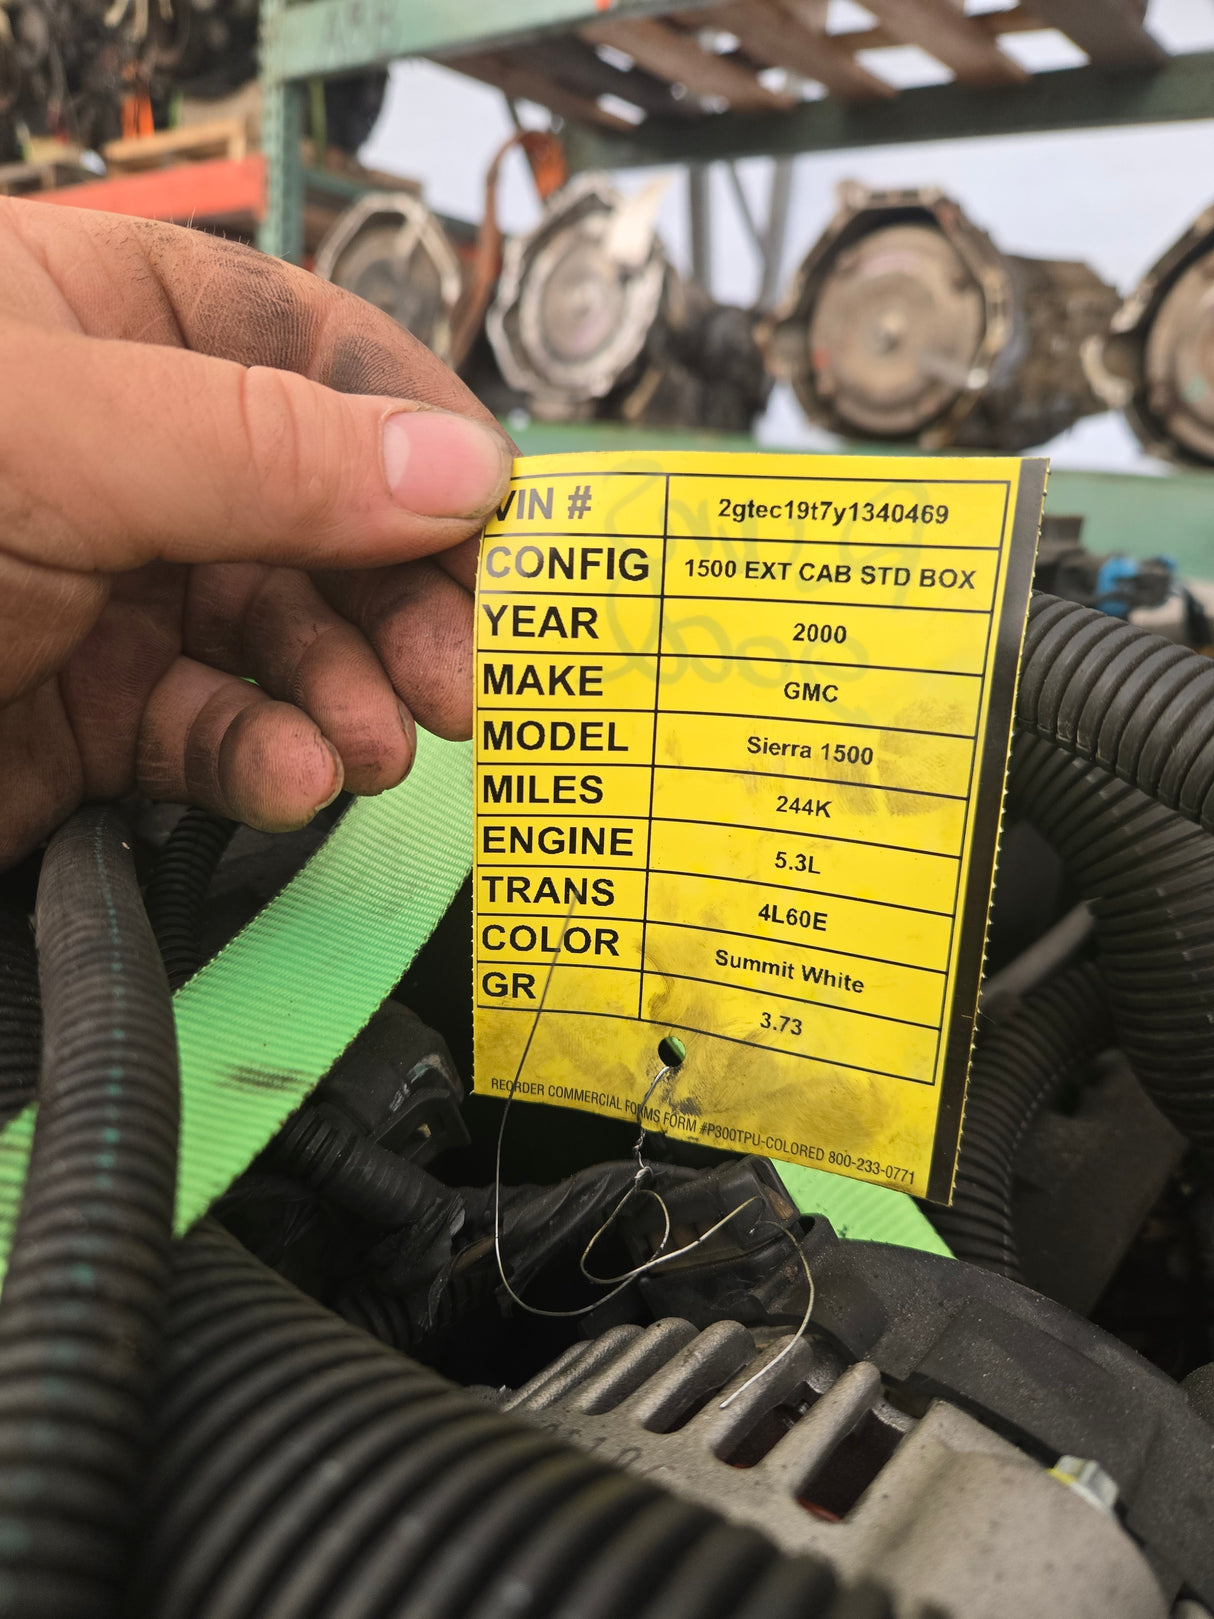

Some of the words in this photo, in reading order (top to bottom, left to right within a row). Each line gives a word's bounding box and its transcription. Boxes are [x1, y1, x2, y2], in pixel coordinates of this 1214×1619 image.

[568, 486, 591, 519] #
[719, 499, 948, 526] 2gtec19t7y1340469
[484, 544, 650, 583] CONFIG
[686, 559, 736, 577] 1500
[745, 561, 792, 580] EXT
[799, 563, 851, 583] CAB
[861, 566, 910, 586] STD
[920, 569, 976, 589] BOX
[483, 605, 598, 639] YEAR
[793, 623, 846, 643] 2000
[484, 664, 603, 696] MAKE
[784, 682, 838, 703] GMC
[484, 721, 628, 751] MODEL
[748, 736, 811, 758] Sierra
[821, 744, 873, 765] 1500
[484, 775, 603, 804] MILES
[776, 796, 831, 818] 244K
[484, 826, 633, 856] ENGINE
[775, 852, 820, 874] 5.3L
[482, 876, 614, 906] TRANS
[759, 904, 827, 931] 4L60E
[481, 923, 621, 957] COLOR
[482, 972, 536, 999] GR
[715, 950, 794, 979] Summit
[802, 965, 864, 993] White
[760, 1012, 802, 1035] 3.73
[491, 1077, 545, 1097] REORDER
[549, 1086, 622, 1109] COMMERCIAL
[624, 1098, 661, 1124] FORMS
[663, 1112, 698, 1133] FORM
[700, 1122, 825, 1161] #P300TPU-COLORED
[828, 1150, 915, 1185] 800-233-0771
